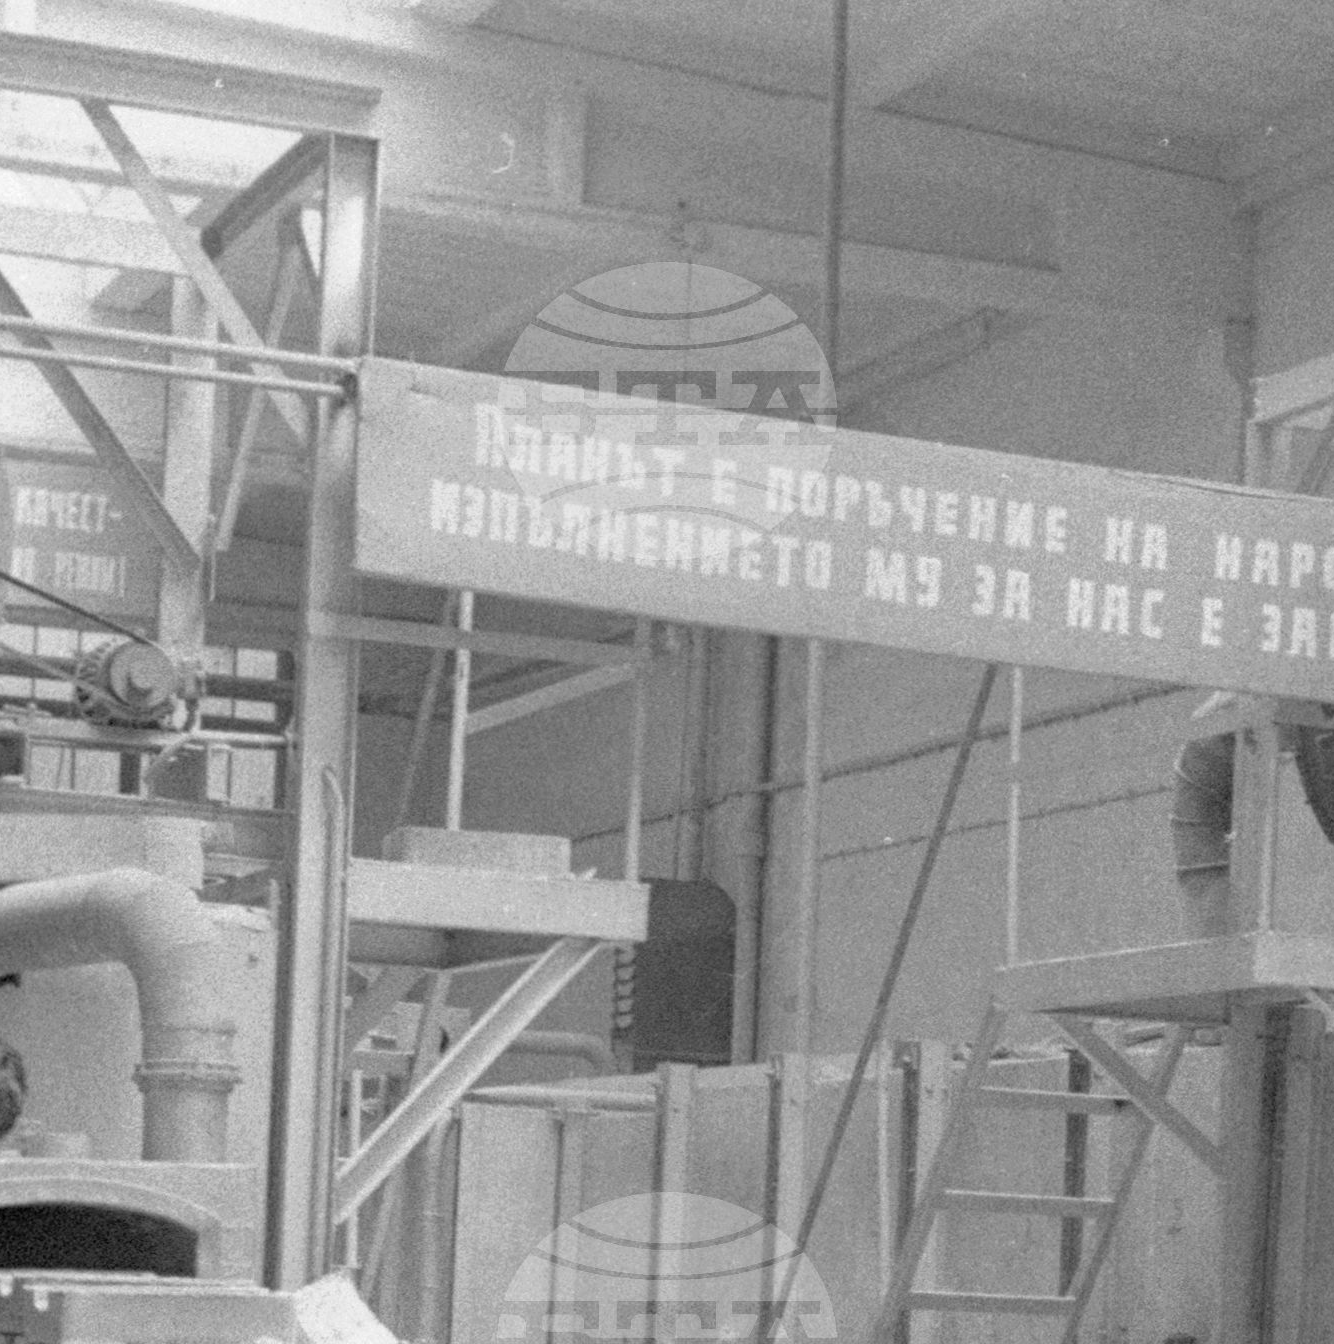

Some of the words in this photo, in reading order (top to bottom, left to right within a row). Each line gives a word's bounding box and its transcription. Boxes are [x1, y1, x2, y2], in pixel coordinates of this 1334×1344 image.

[430, 479, 832, 589] ИЗПЪЛНЕНИЕТО
[866, 548, 942, 607] МУ
[974, 564, 1031, 621] ЗА
[1067, 578, 1165, 639] НАС
[1201, 597, 1223, 647] Е
[475, 404, 685, 498] ПЛАНЪТ
[712, 459, 738, 504] Е
[767, 466, 1067, 553] ПОРЪЧЕНИЕ
[1105, 517, 1168, 571] НА
